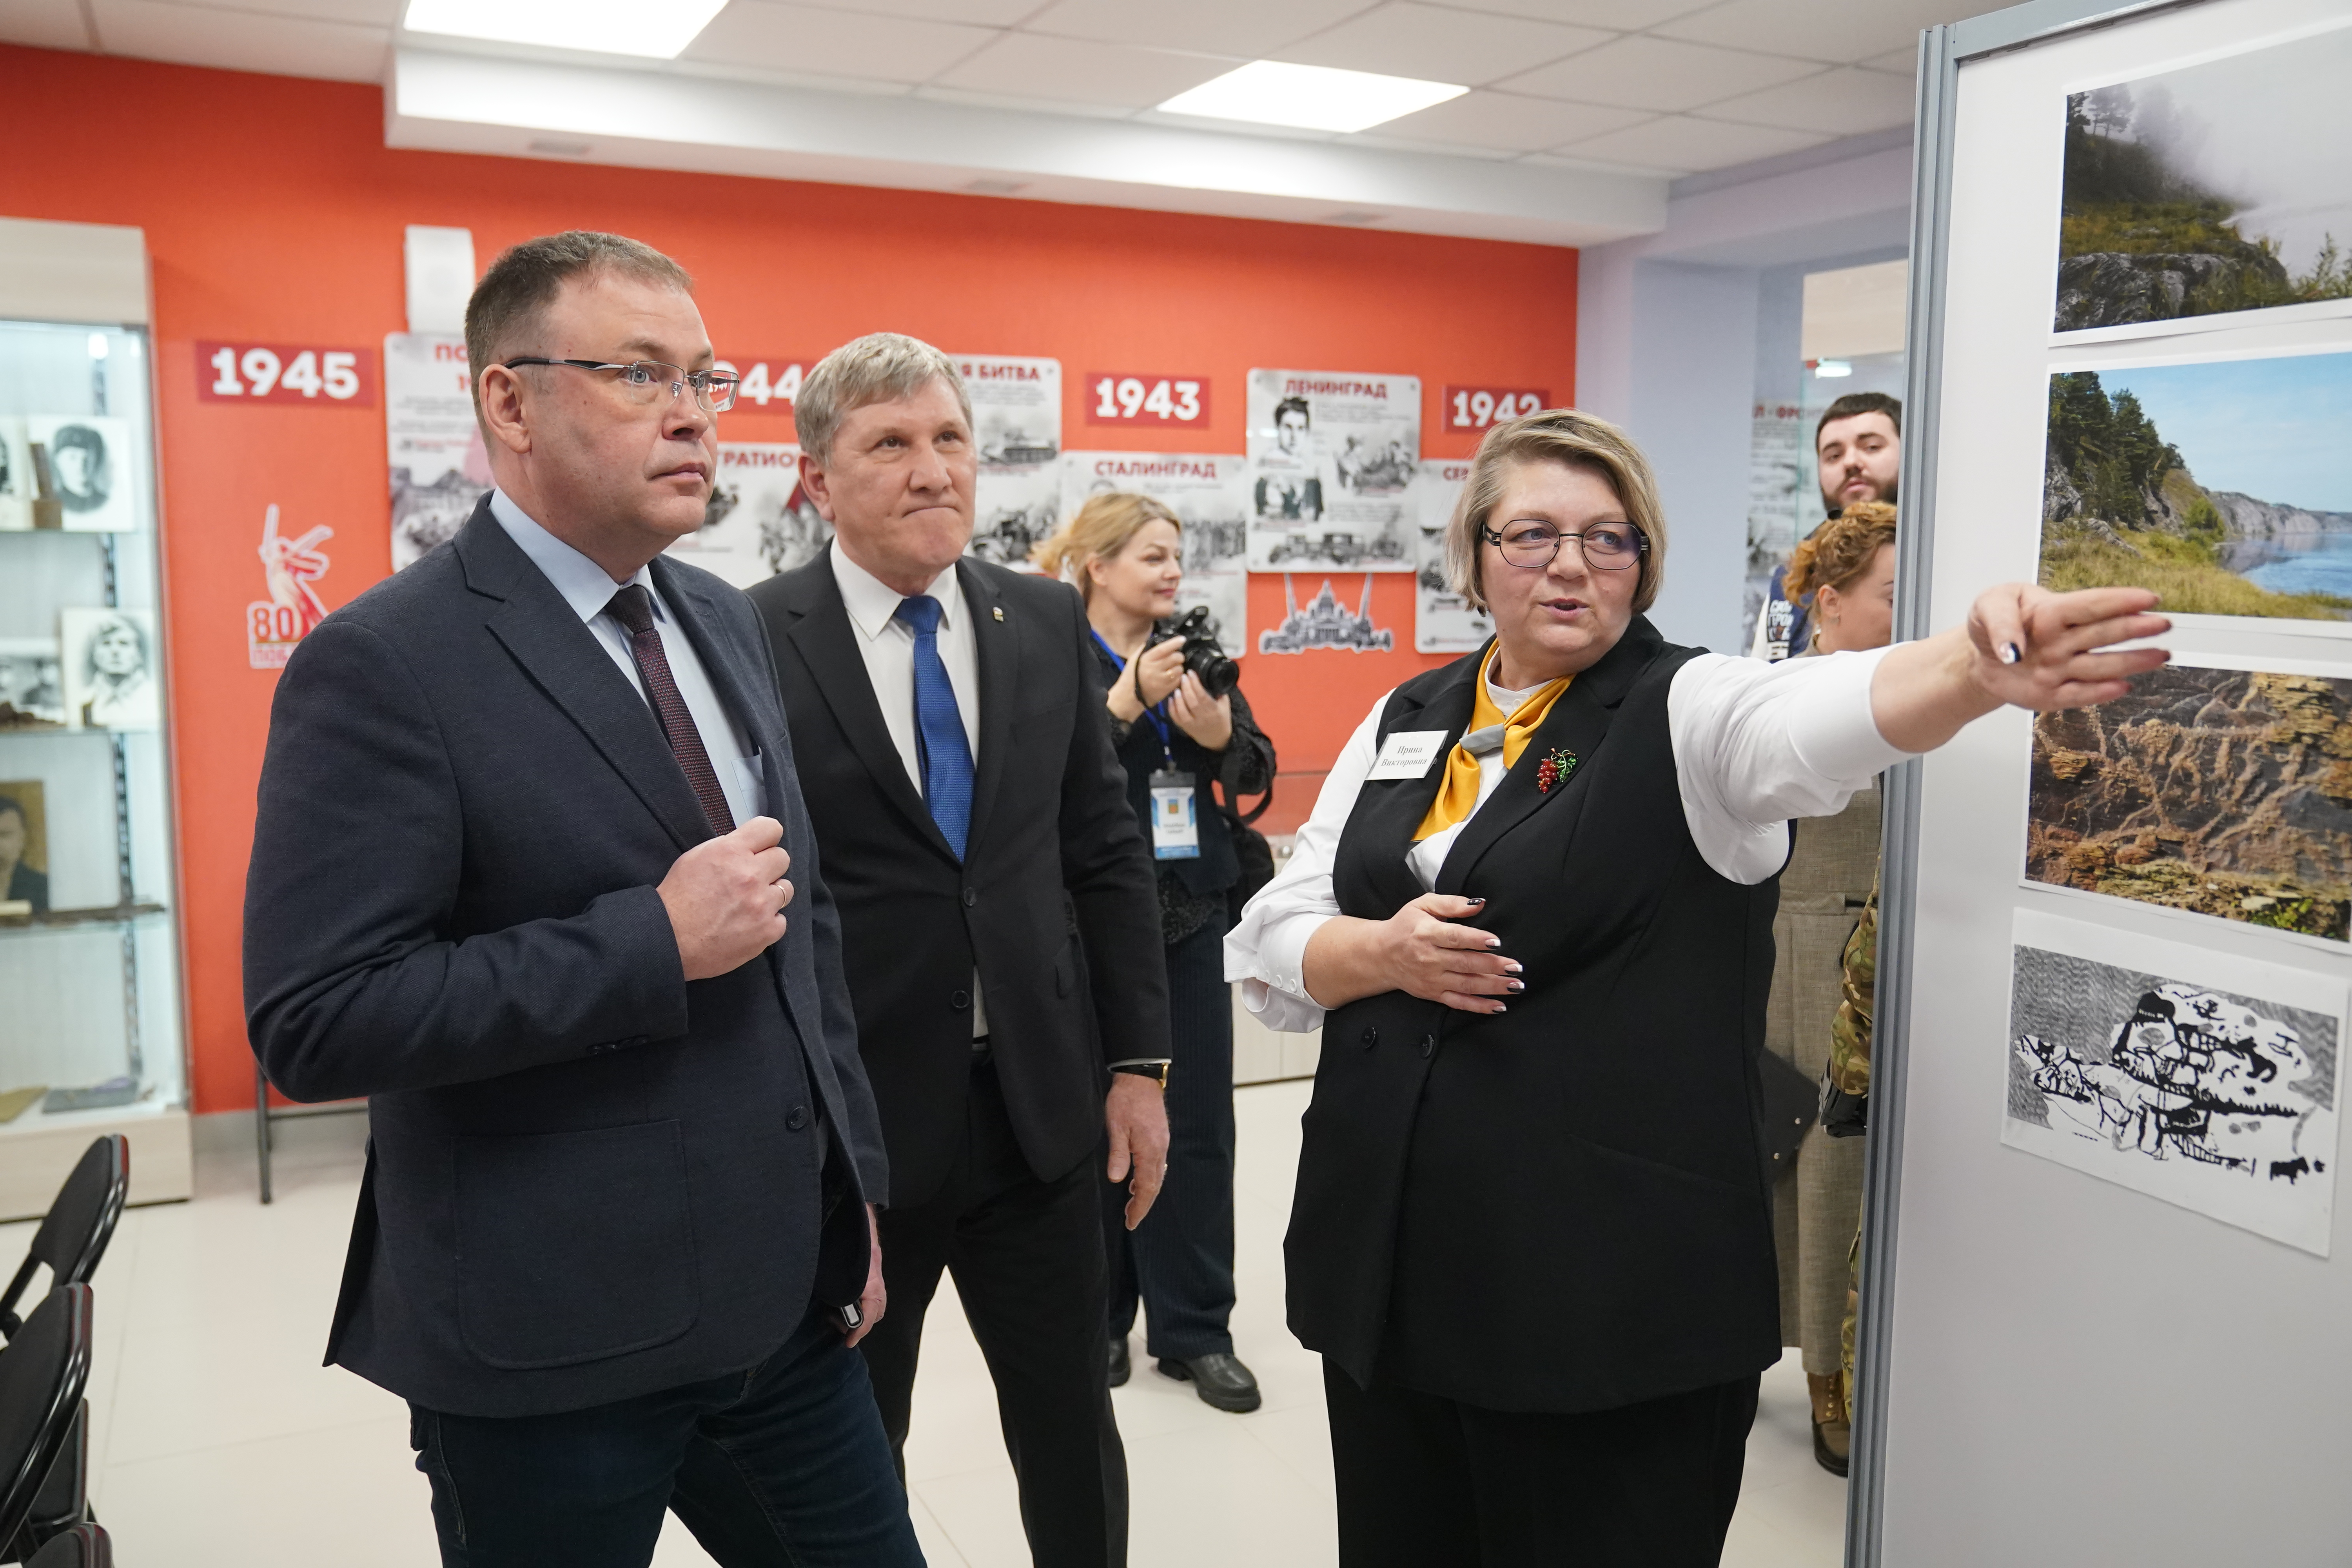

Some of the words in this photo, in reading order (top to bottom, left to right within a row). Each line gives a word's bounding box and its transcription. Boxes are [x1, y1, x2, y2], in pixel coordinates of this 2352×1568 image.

[436, 343, 470, 362] ПО
[211, 347, 359, 400] 1945
[979, 365, 1040, 382] БИТВА
[1286, 379, 1388, 399] ЛЕНИНГРАД
[1095, 377, 1200, 421] 1943
[1453, 390, 1541, 427] 1942
[1094, 461, 1217, 480] СТАЛИНГРАД
[253, 607, 293, 642] 80
[1397, 746, 1423, 755] Ирина
[1381, 759, 1427, 768] Викторовна
